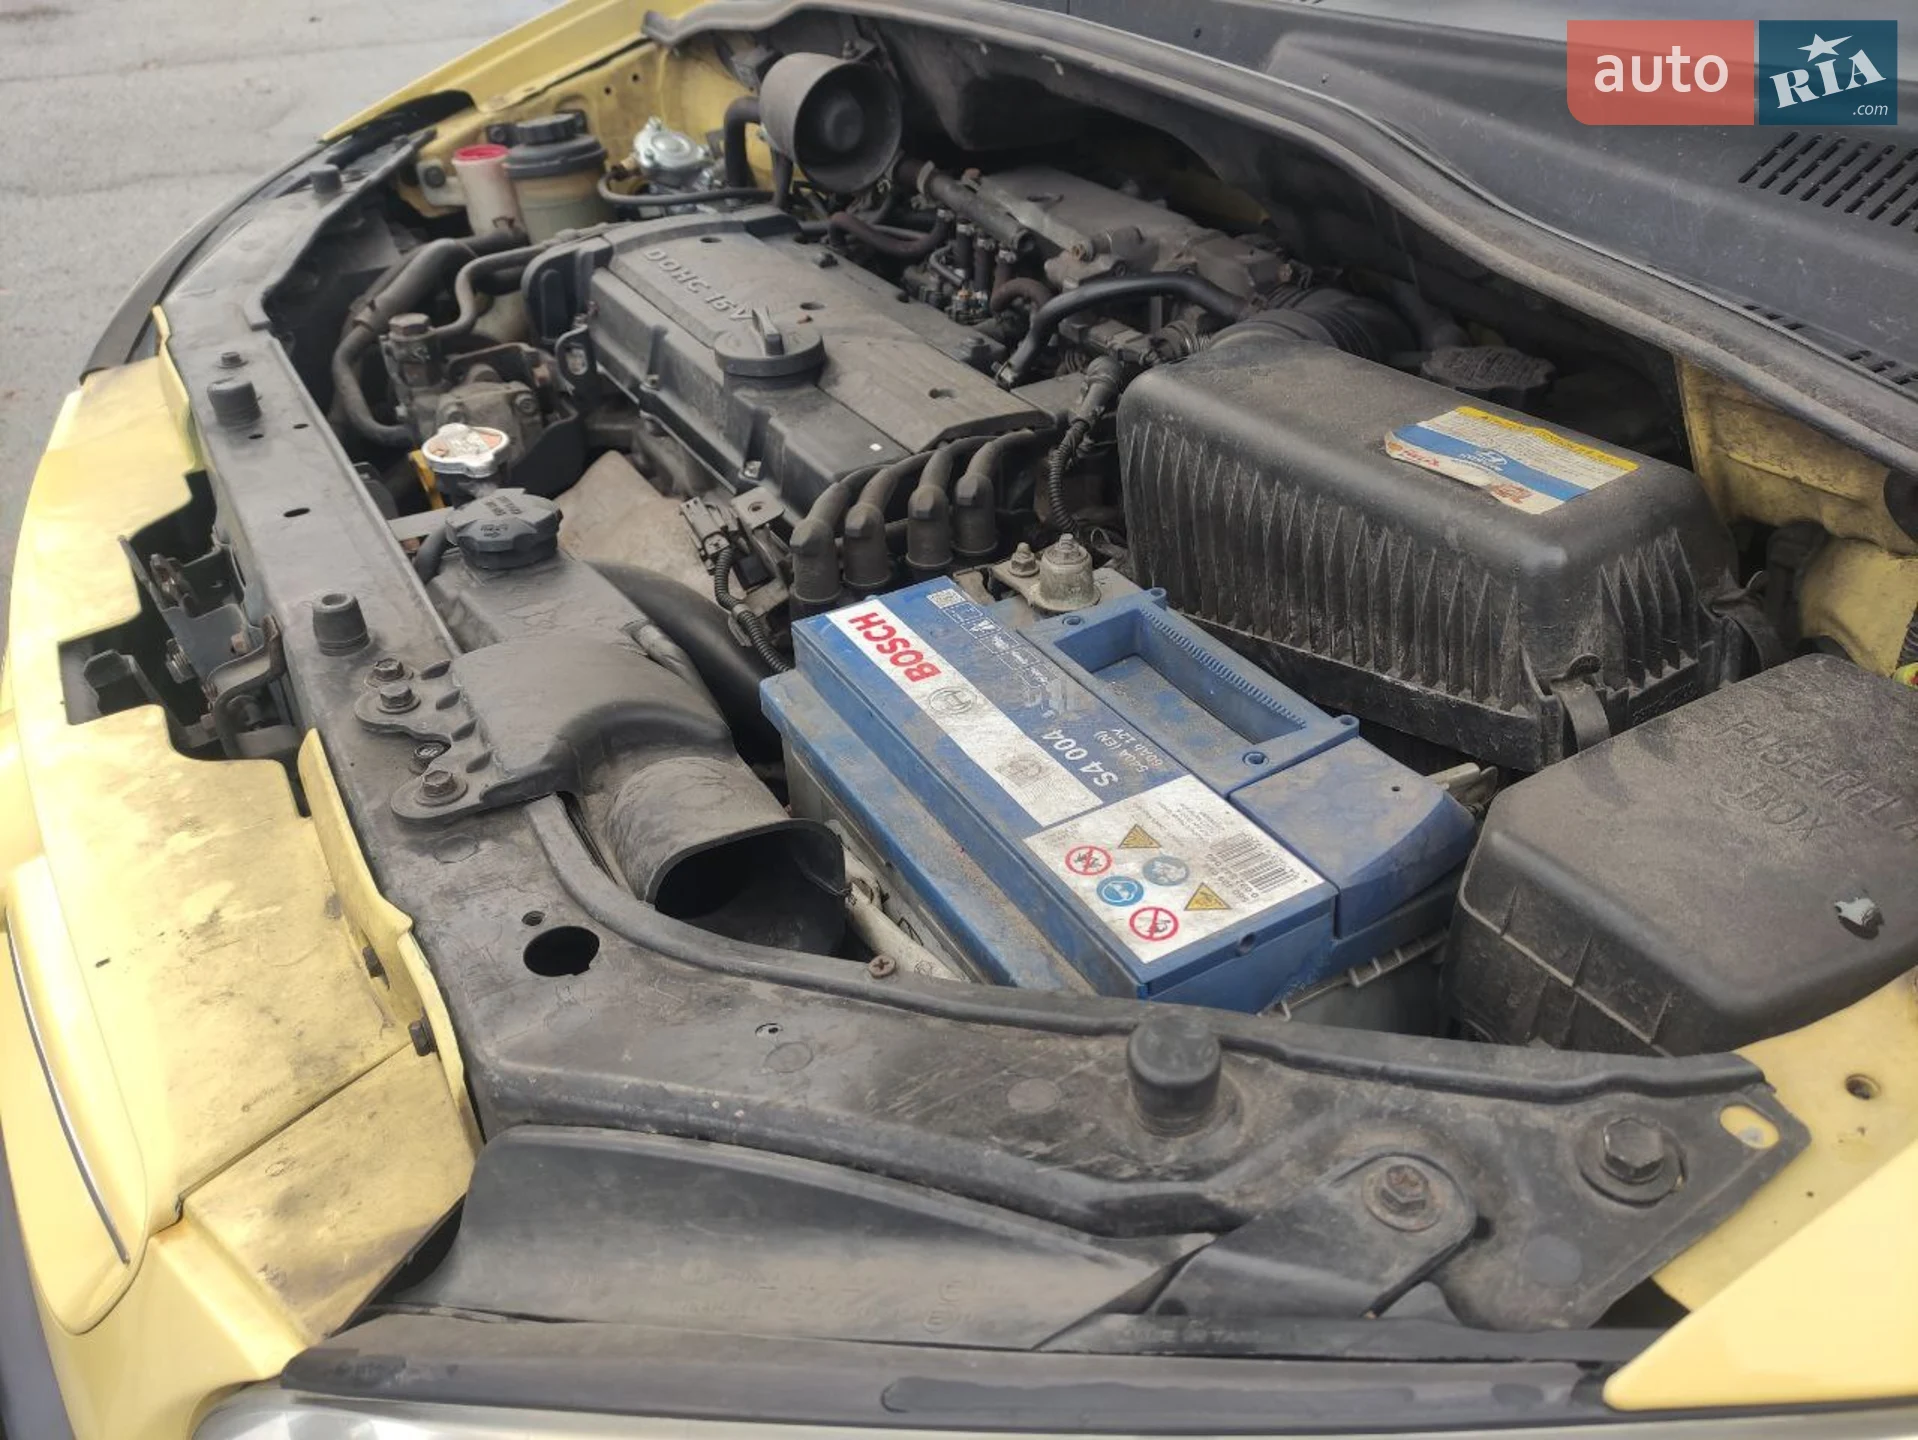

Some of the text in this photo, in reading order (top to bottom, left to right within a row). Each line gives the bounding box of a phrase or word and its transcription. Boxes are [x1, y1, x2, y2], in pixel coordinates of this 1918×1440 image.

[644, 249, 711, 294] DOHC
[848, 612, 942, 682] BOSCH
[1041, 729, 1119, 787] S4 004
